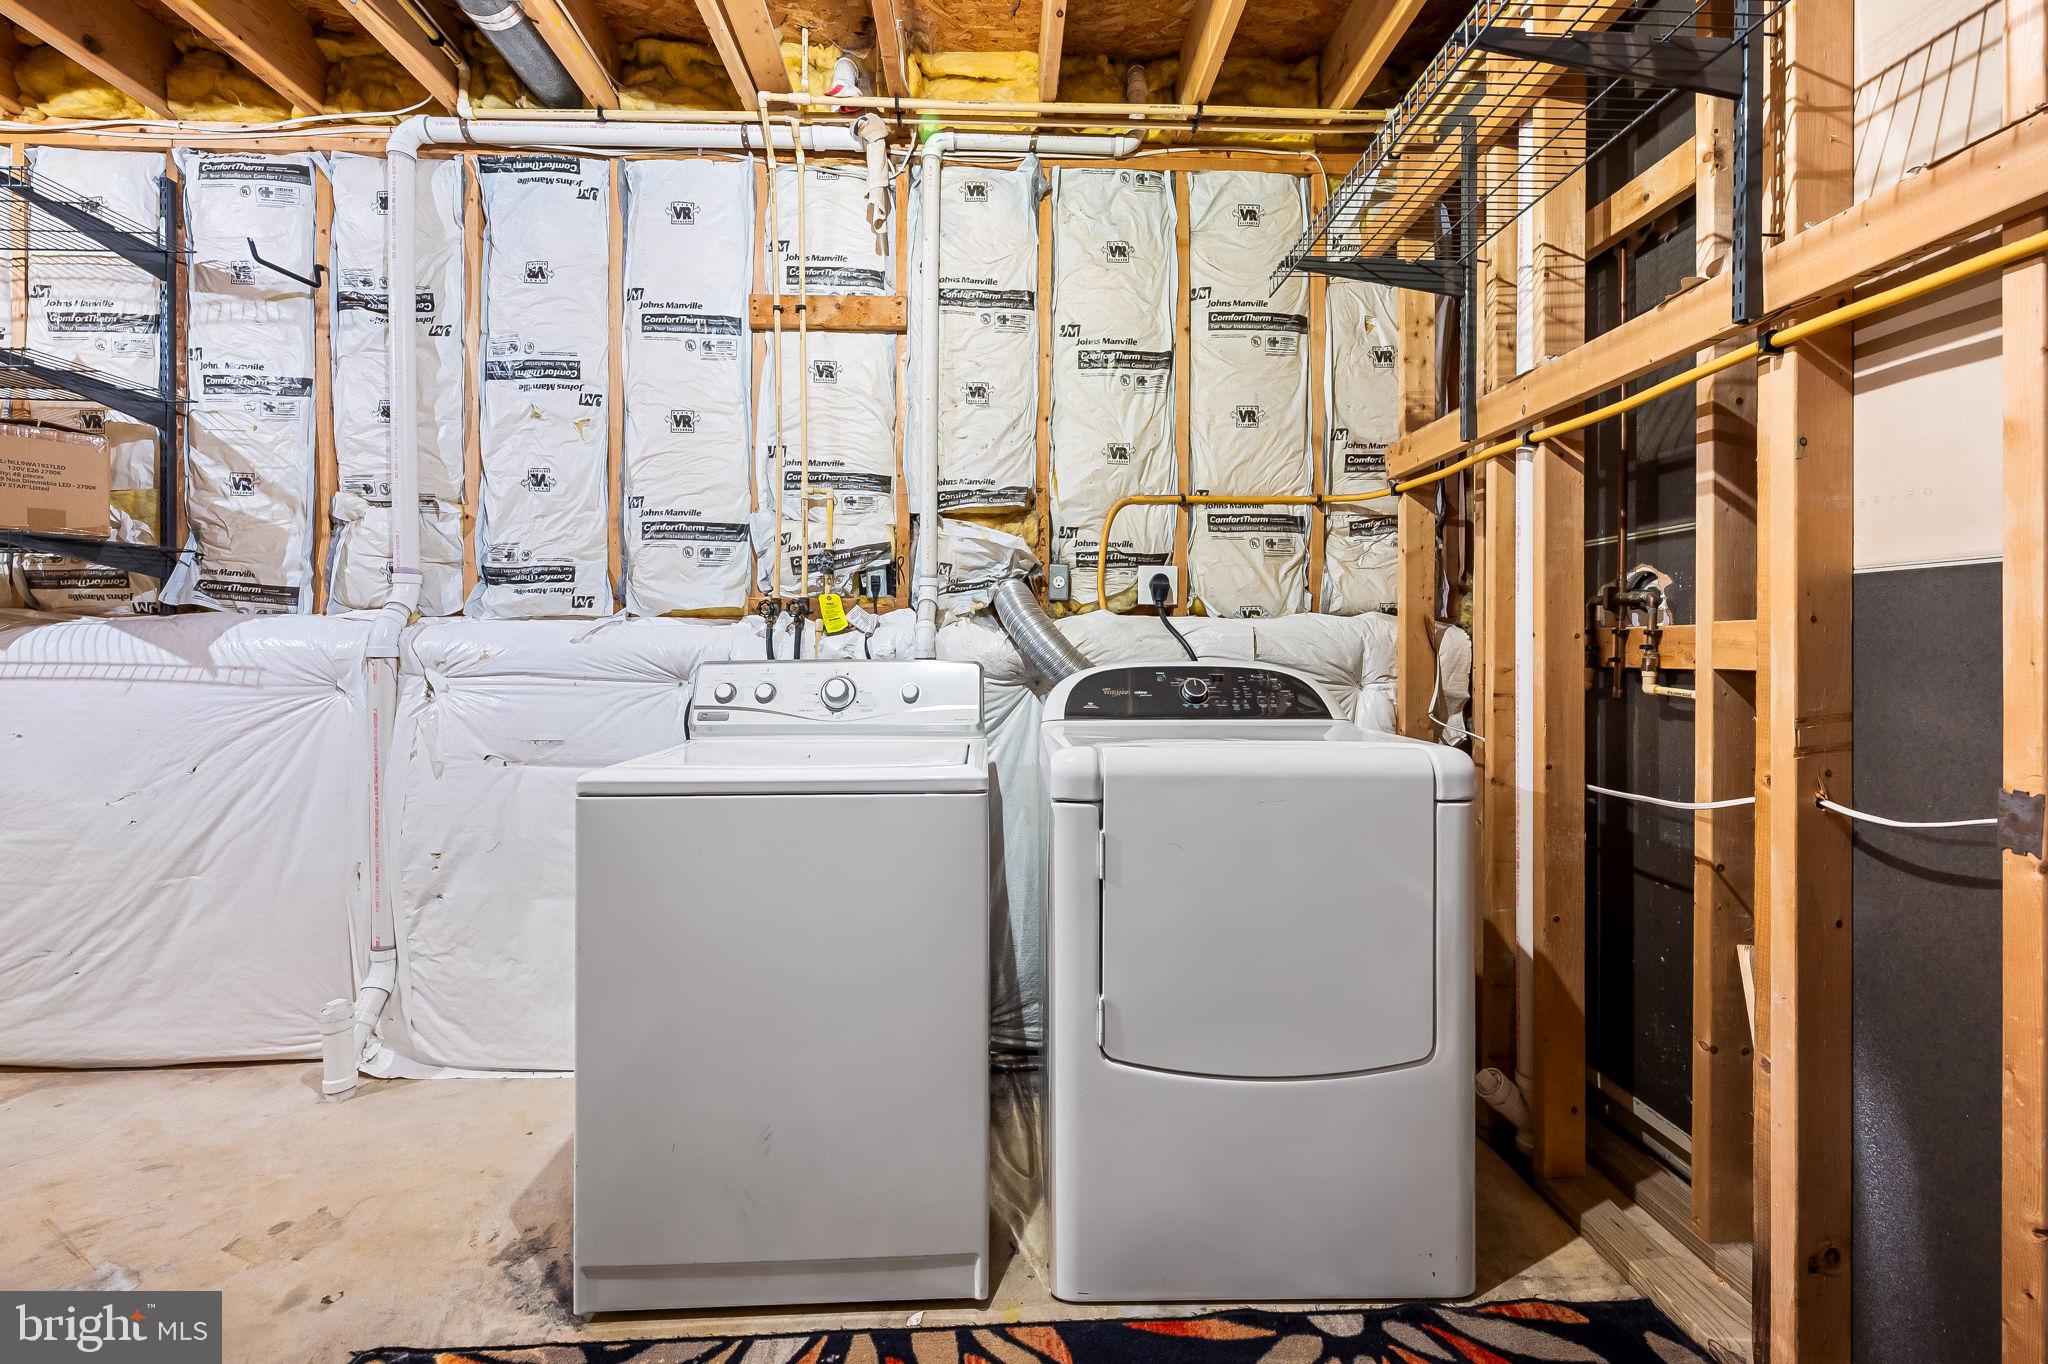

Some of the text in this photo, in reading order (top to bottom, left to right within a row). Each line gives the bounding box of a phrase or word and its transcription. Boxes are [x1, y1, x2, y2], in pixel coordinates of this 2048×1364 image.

[513, 162, 577, 172] ComfortTherm
[517, 177, 583, 188] Johns Manville
[967, 184, 986, 197] VR
[673, 206, 693, 220] VR
[1240, 209, 1258, 221] VR
[784, 253, 848, 263] Johs Manville
[939, 276, 998, 286] ohns Manville
[44, 300, 72, 308] Johns
[639, 301, 664, 309] Johns
[1207, 300, 1268, 308] Johns Manville
[50, 312, 117, 324] ComfortTherm
[416, 316, 436, 324] John
[643, 315, 706, 325] ComfortTherm
[1211, 314, 1271, 322] ComfortTherm
[1102, 337, 1138, 346] Manville
[1375, 351, 1393, 363] VR
[557, 384, 584, 392] Johns
[81, 414, 103, 429] VR
[673, 415, 693, 428] VR
[1239, 411, 1257, 423] VR
[1343, 441, 1367, 450] Johns
[1109, 447, 1128, 459] VR
[808, 459, 845, 467] Manville
[22, 478, 57, 487] Dimmable
[639, 509, 702, 517] Johns Manville
[643, 523, 705, 531] ComfortTherm
[787, 543, 811, 552] Johs
[1078, 553, 1136, 563] ComrtTherm
[60, 579, 127, 588] ComfortTherm
[549, 587, 577, 595] Johns
[107, 593, 134, 602] Johns
